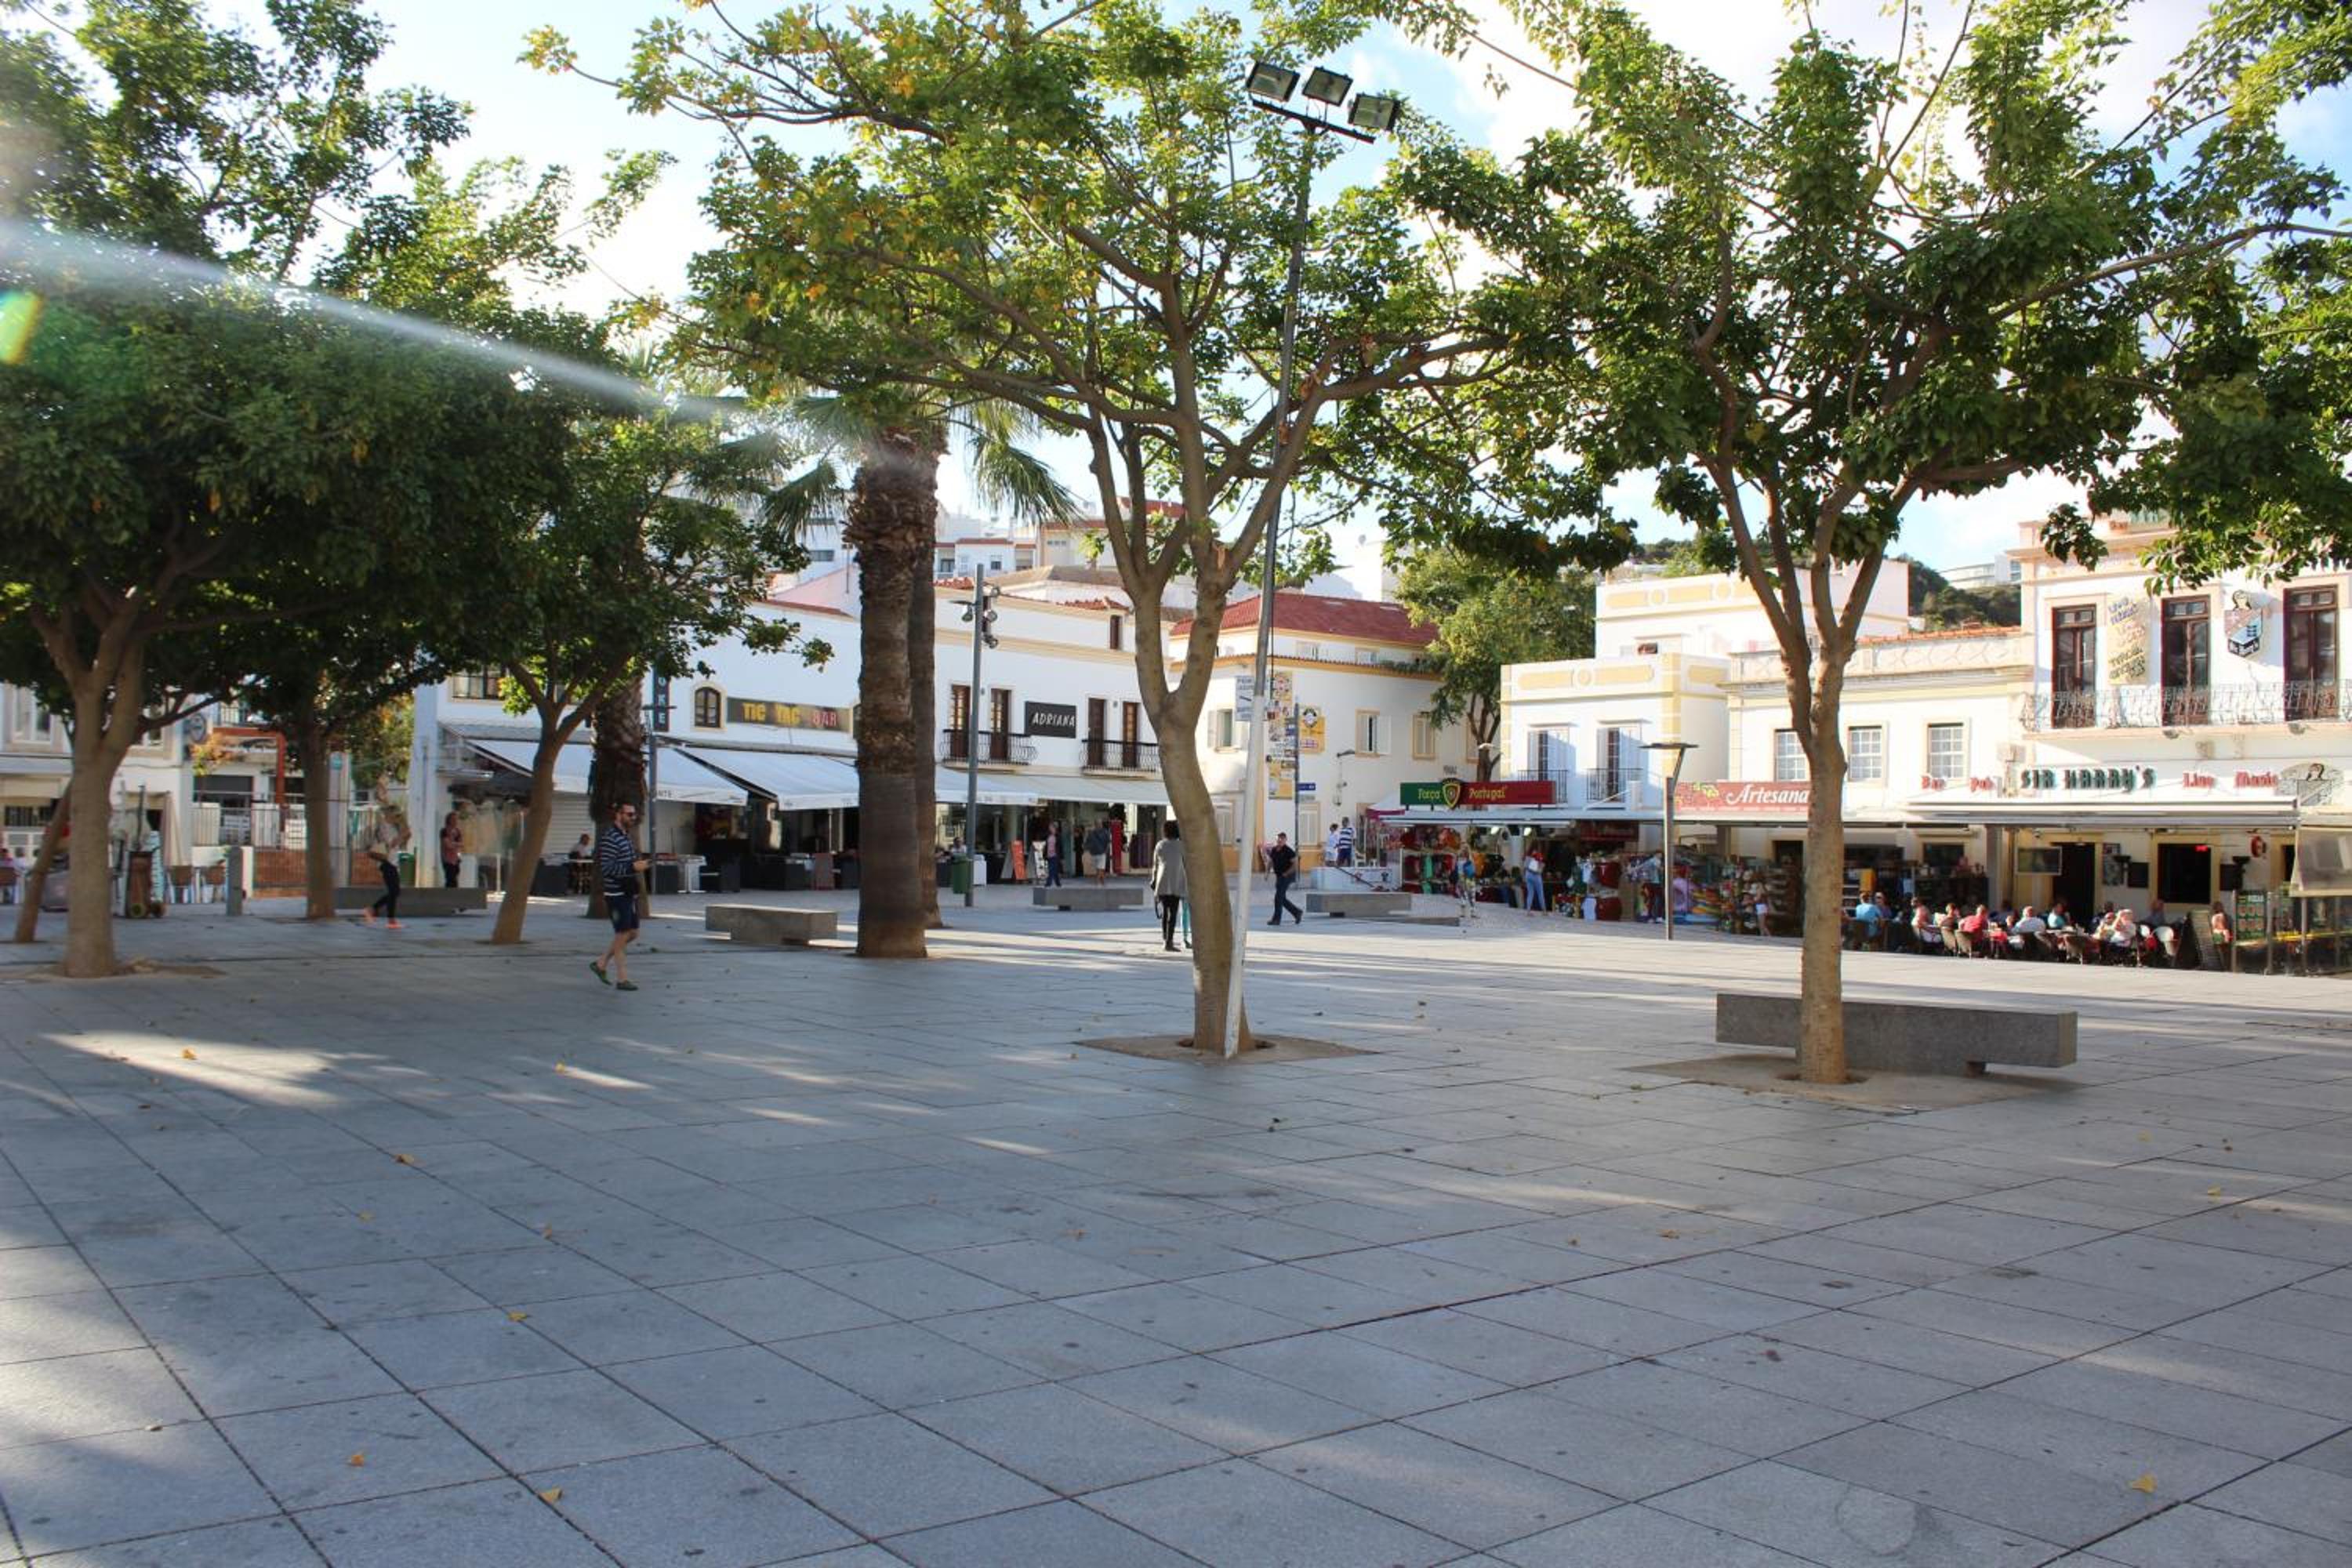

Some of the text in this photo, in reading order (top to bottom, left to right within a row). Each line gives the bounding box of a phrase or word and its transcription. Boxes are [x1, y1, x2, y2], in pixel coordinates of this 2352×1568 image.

[1032, 711, 1075, 727] ADRIANA
[2020, 768, 2056, 789] SIR
[1726, 783, 1809, 805] Artesana
